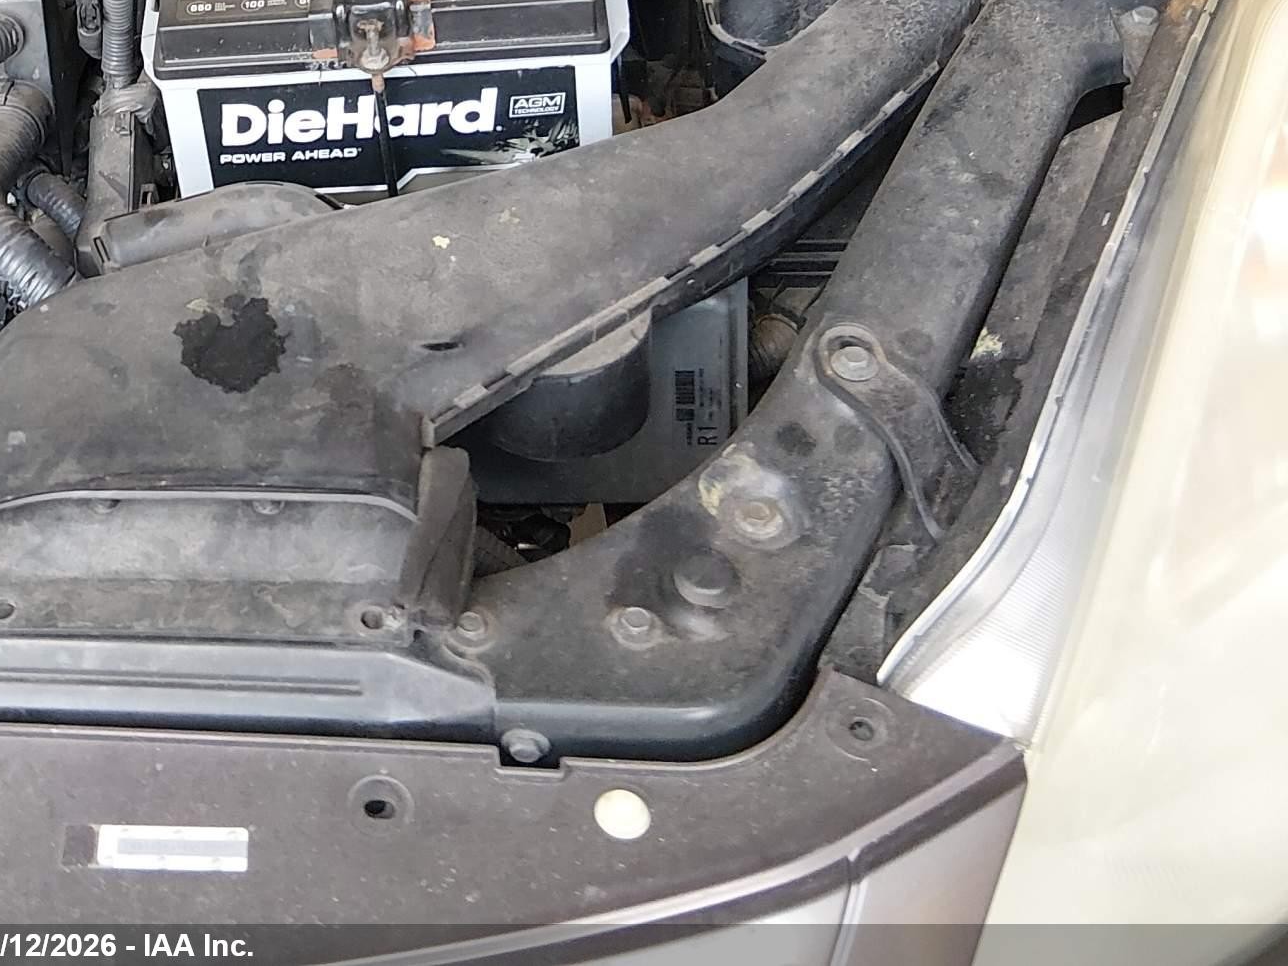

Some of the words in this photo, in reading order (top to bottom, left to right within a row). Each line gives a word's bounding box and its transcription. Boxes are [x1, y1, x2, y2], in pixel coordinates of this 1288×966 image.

[514, 95, 561, 109] AGM
[220, 87, 499, 147] DieHard
[219, 150, 286, 165] POWER
[291, 148, 358, 162] AHEAD
